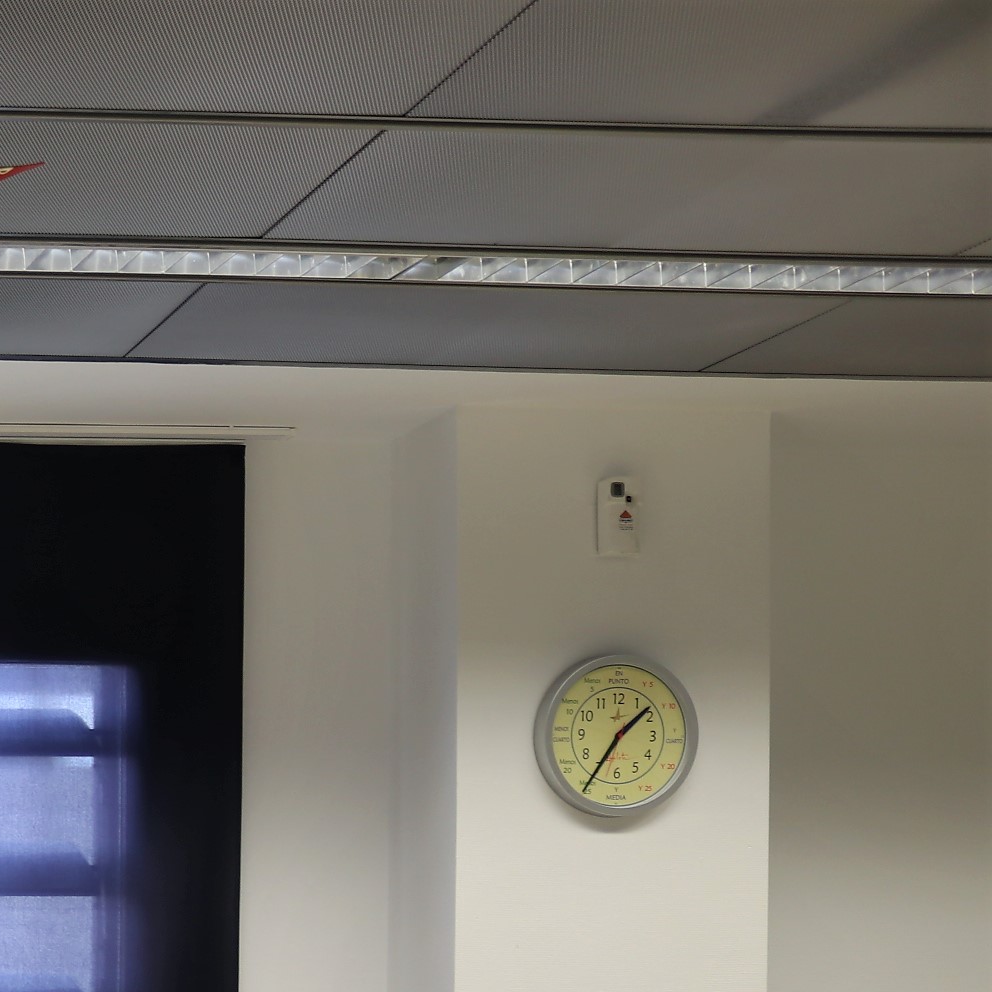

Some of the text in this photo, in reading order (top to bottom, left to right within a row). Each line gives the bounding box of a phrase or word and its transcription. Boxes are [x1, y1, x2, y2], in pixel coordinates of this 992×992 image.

[596, 698, 606, 709] 11
[612, 693, 625, 705] 12
[635, 697, 639, 709] 1
[581, 710, 594, 722] 10
[646, 710, 653, 723] 2
[578, 728, 585, 741] 9
[649, 730, 656, 742] 3
[582, 748, 590, 760] 8
[644, 749, 652, 760] 4
[613, 767, 621, 779] 6
[632, 762, 639, 774] 5
